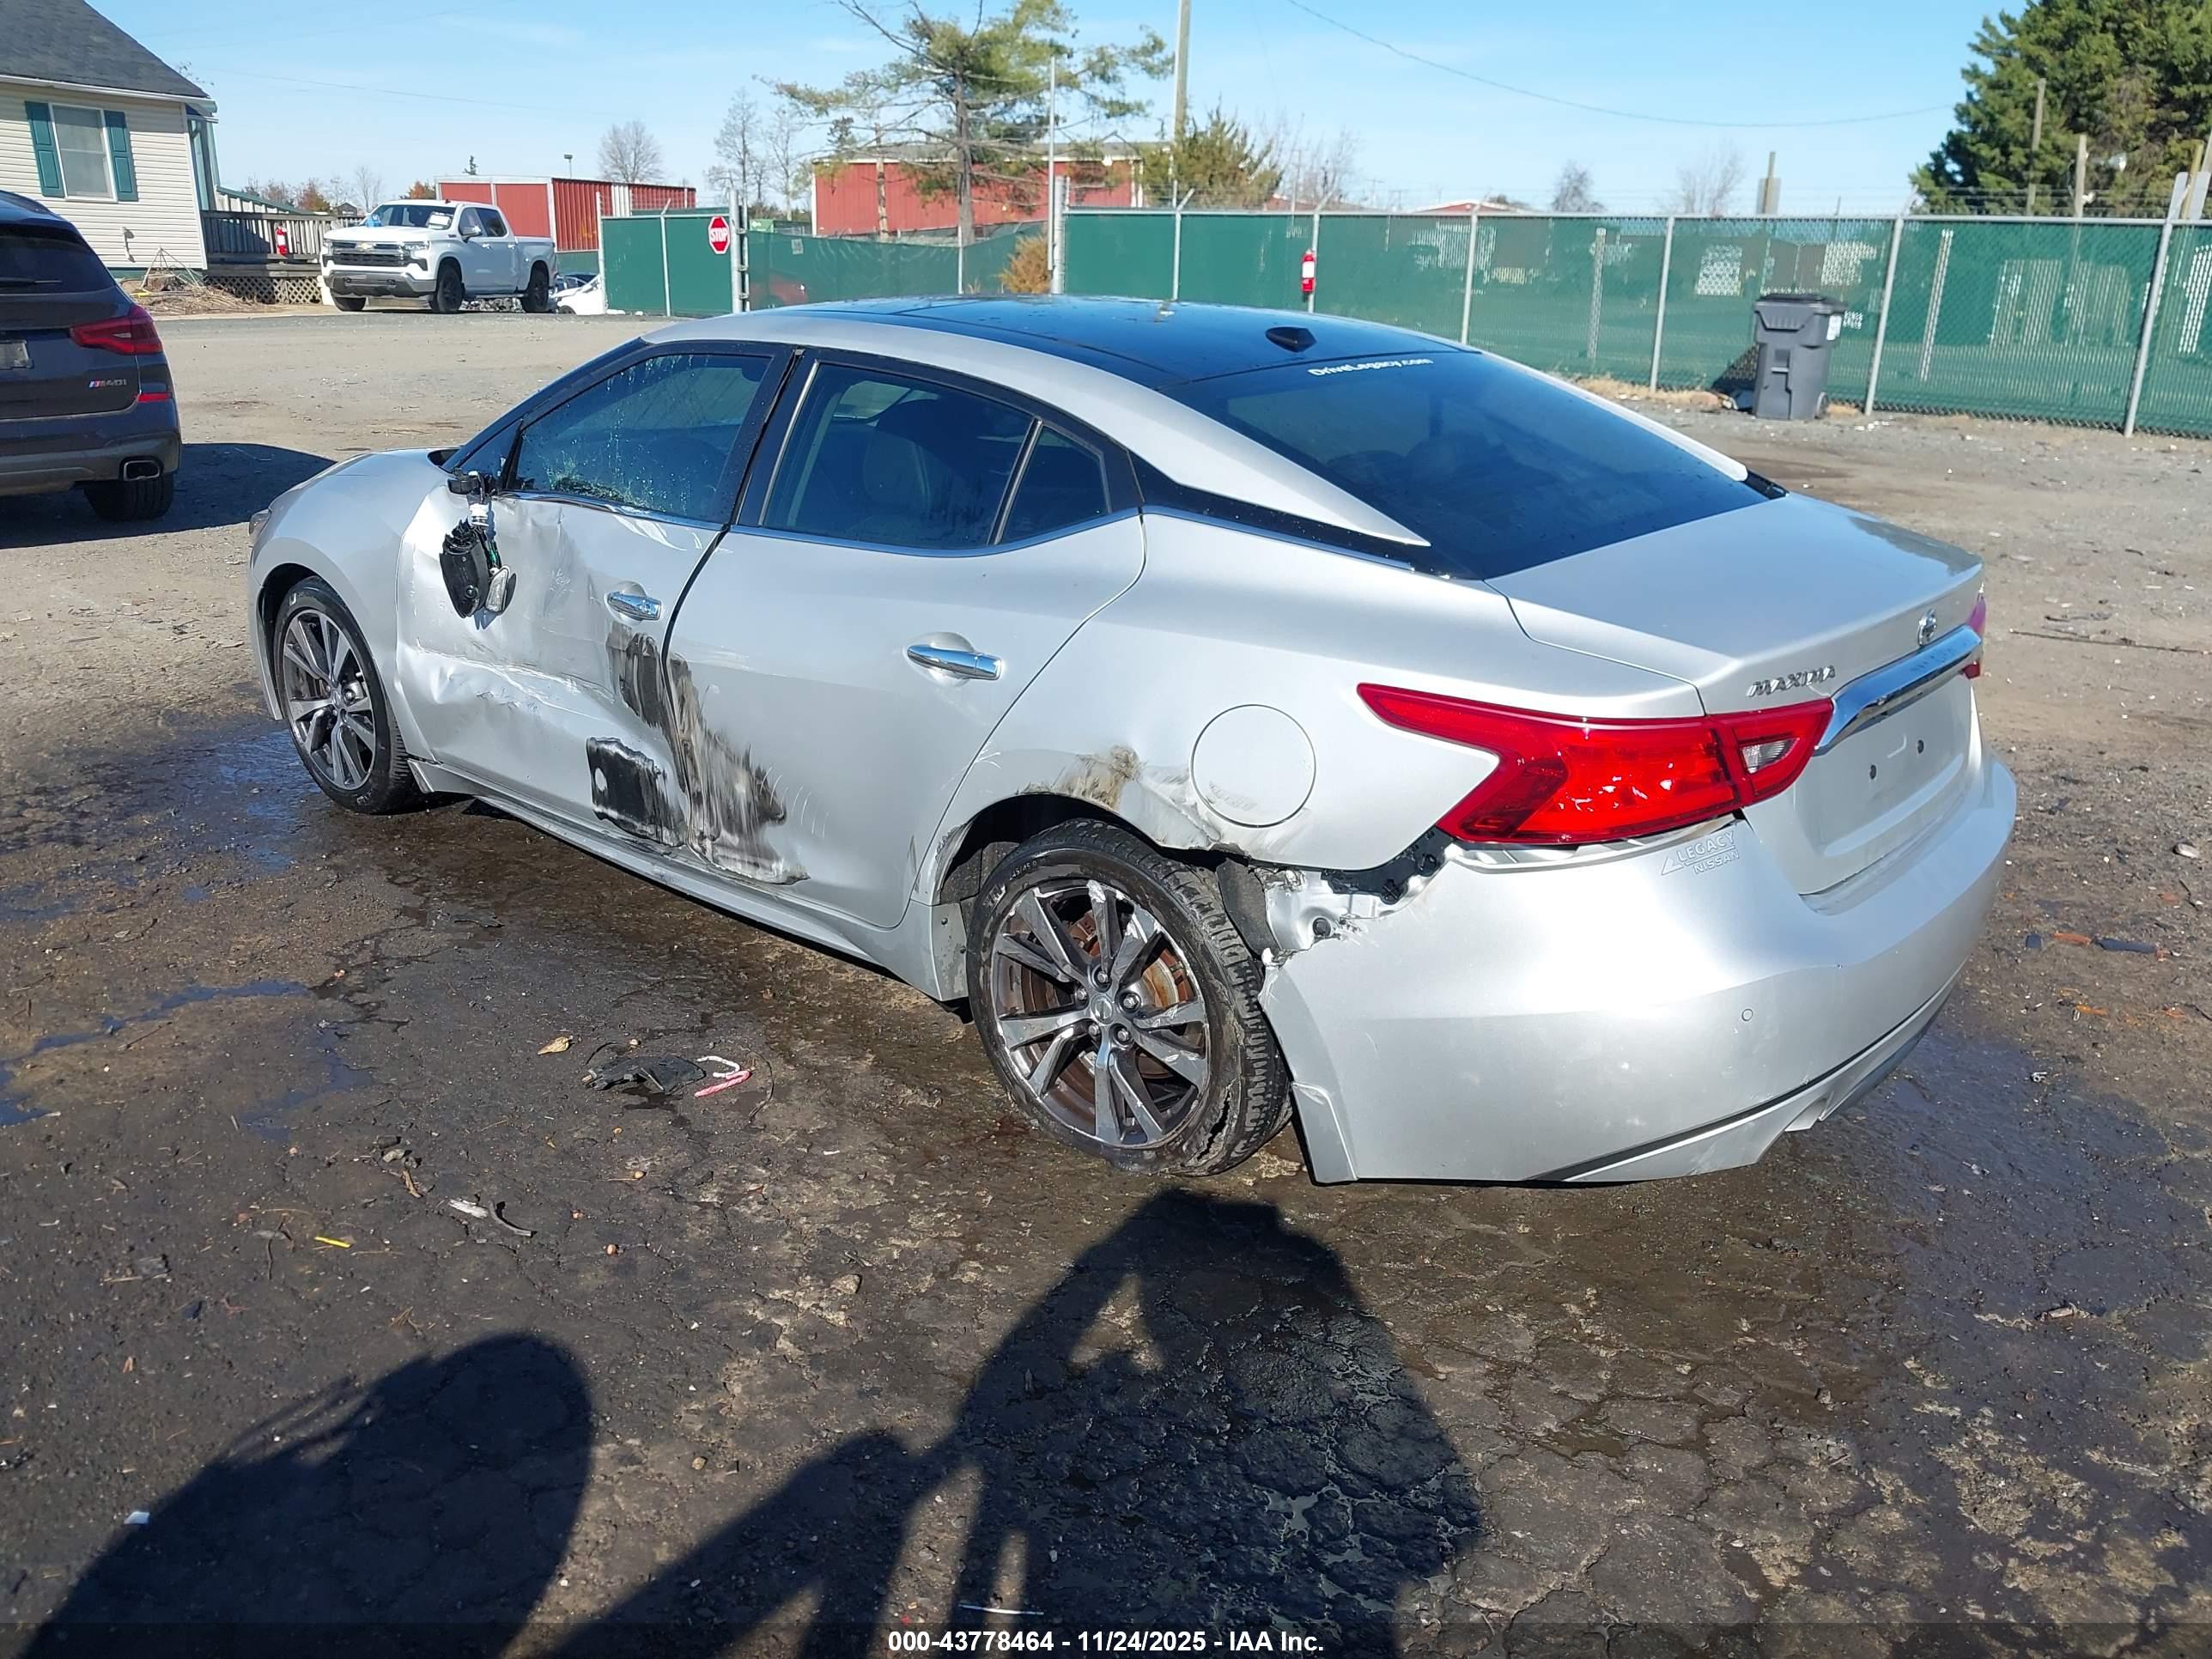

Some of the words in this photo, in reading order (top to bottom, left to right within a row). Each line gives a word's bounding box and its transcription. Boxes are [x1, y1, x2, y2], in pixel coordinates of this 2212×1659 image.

[709, 227, 729, 242] STOP
[1307, 359, 1434, 376] DriveLegacy.com
[1747, 665, 1836, 697] MAXIMA
[1676, 830, 1735, 862] LEGACY
[1692, 850, 1740, 874] NISSAN
